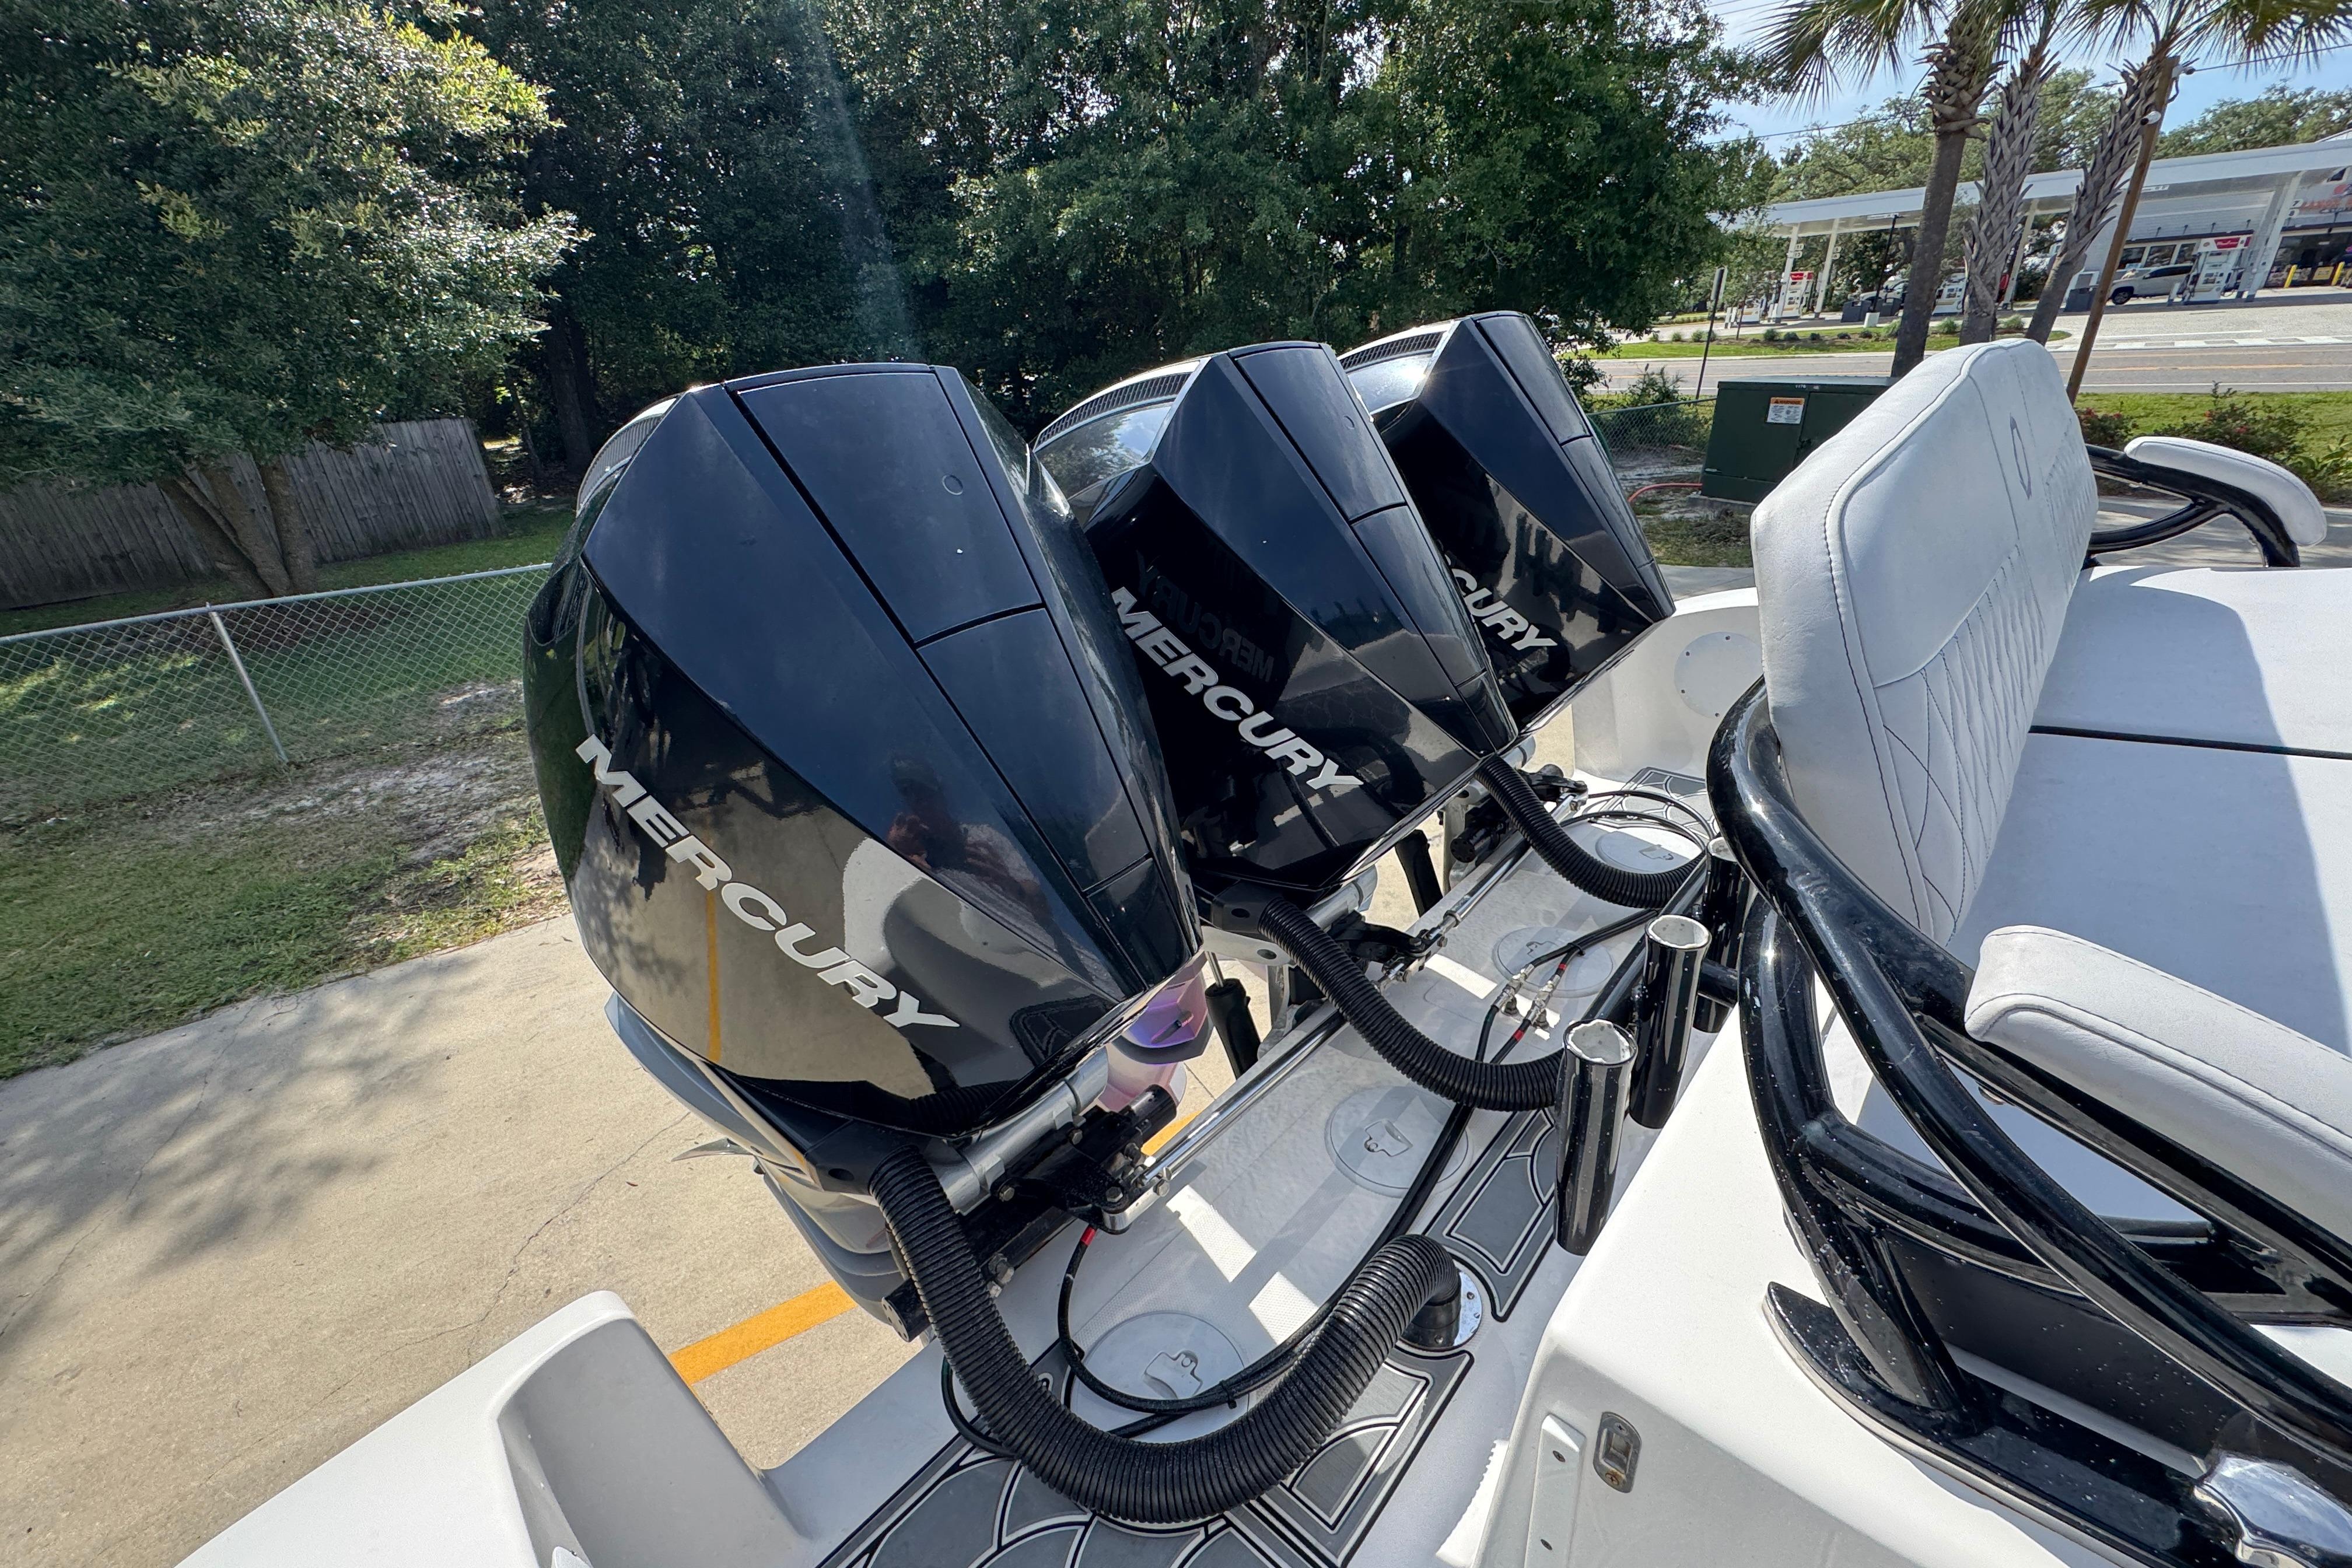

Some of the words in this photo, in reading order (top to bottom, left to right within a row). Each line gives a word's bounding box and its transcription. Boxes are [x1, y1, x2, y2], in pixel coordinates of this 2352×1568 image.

[1111, 586, 1363, 790] MERCURY
[1444, 554, 1558, 650] CURY
[575, 734, 960, 1028] MERCURY
